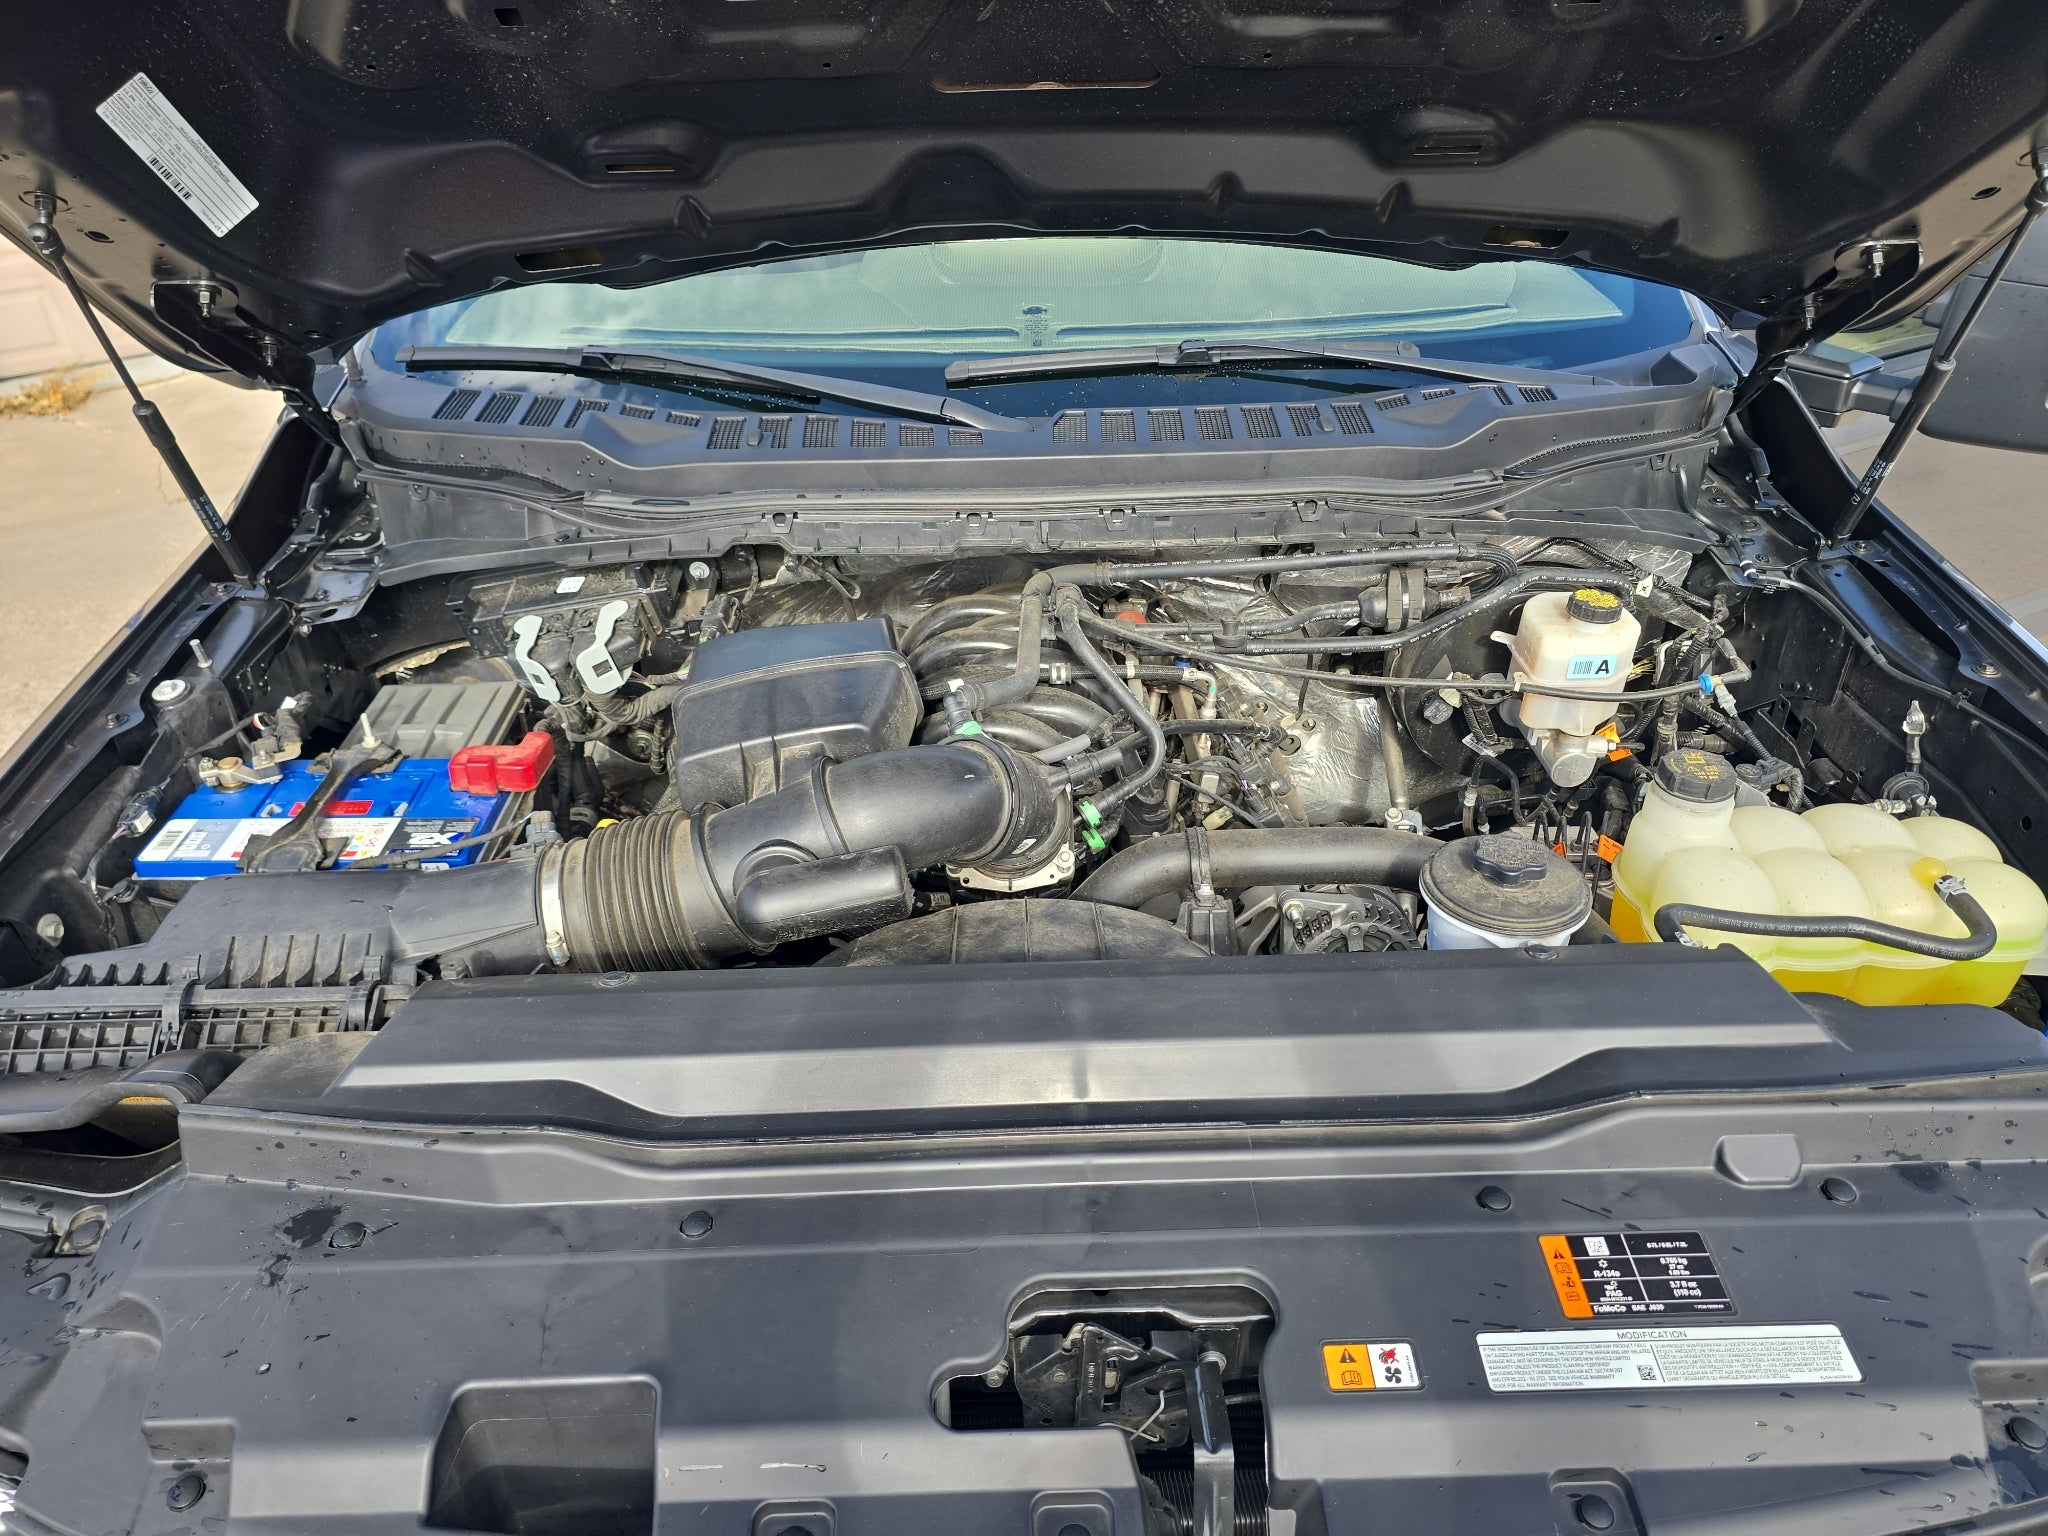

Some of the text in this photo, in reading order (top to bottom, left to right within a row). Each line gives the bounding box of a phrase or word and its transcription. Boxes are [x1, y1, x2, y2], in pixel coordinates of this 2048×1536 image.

[1595, 660, 1610, 675] A
[1594, 1305, 1626, 1313] FoMoCo
[1617, 1330, 1687, 1340] MODIFICATION
